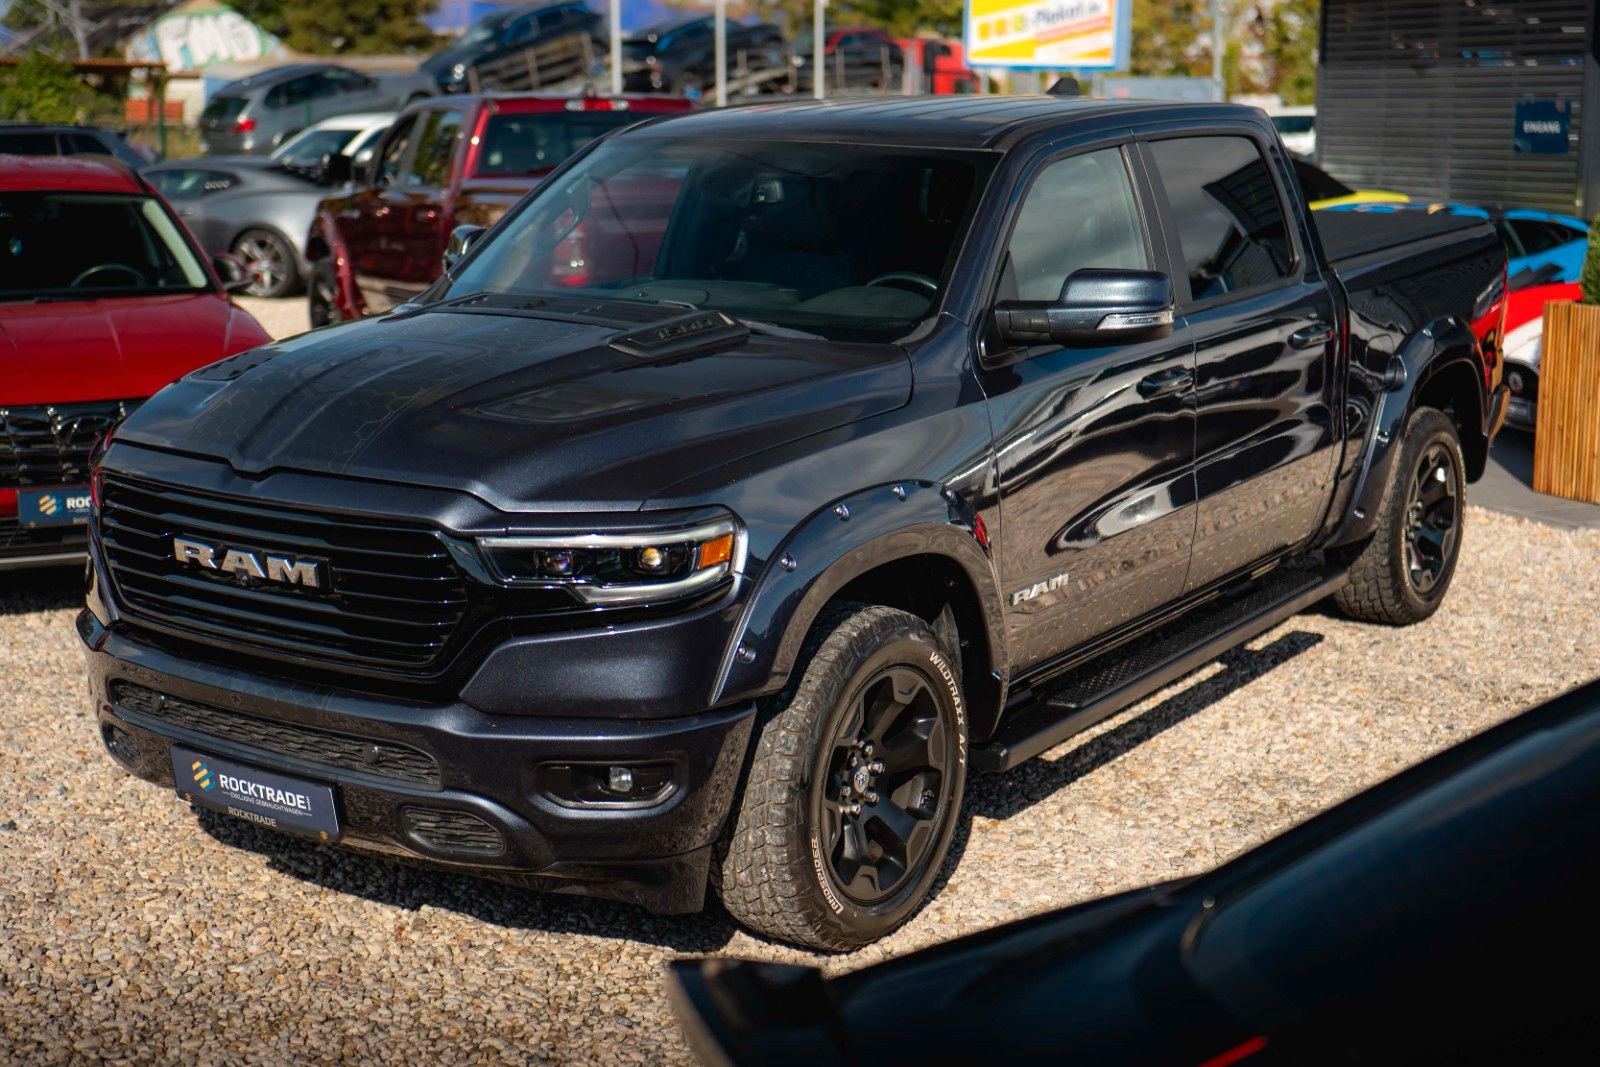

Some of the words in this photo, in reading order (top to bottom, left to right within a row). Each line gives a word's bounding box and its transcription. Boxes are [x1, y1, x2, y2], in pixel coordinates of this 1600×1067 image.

[1523, 120, 1560, 134] EINGANG
[174, 536, 320, 589] RAM
[1009, 571, 1069, 607] RAM
[929, 651, 965, 727] WILDTRAXX
[218, 773, 307, 811] ROCKTRADE
[227, 806, 278, 828] ROCKTRADE
